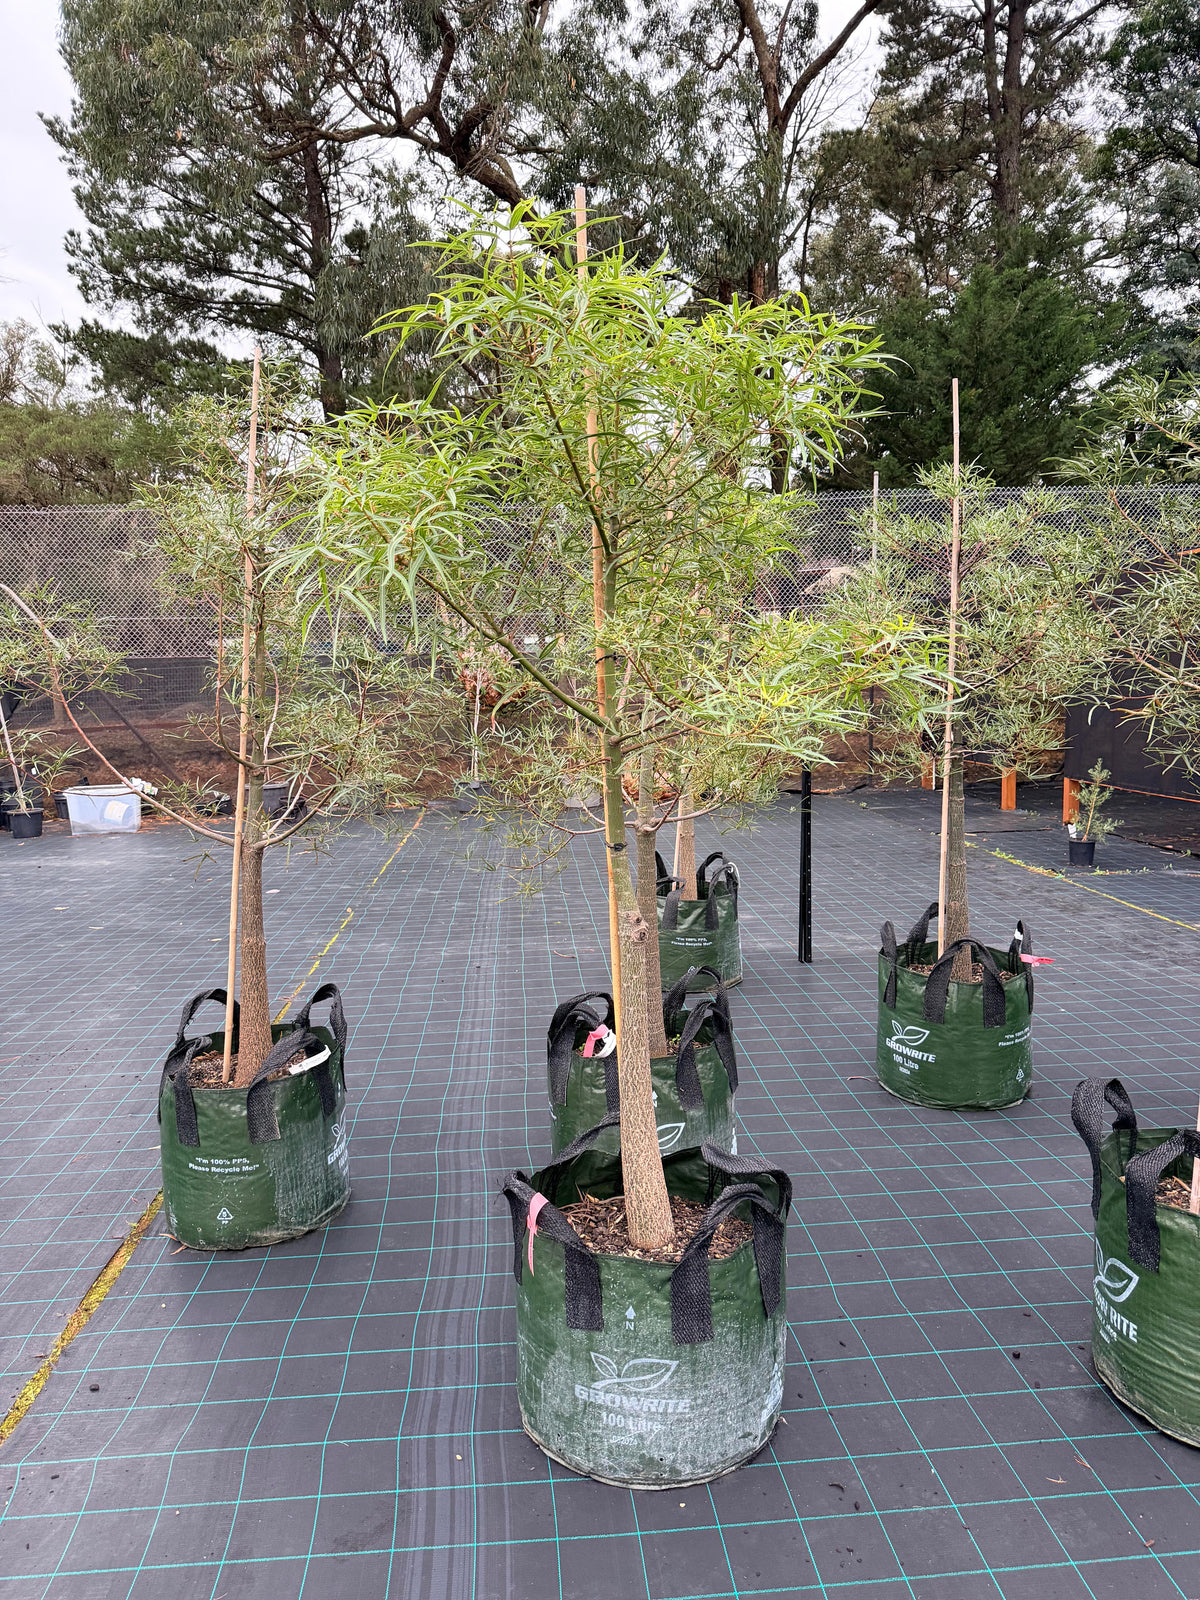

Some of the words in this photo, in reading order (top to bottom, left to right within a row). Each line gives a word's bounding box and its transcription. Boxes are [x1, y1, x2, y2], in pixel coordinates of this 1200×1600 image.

[885, 1037, 937, 1063] GROWRITE
[893, 1053, 903, 1064] 100
[903, 1057, 919, 1070] Litre
[188, 1162, 210, 1172] Please
[210, 1166, 240, 1174] Recycle
[625, 1320, 635, 1331] N
[574, 1384, 692, 1413] GROWRITE
[601, 1411, 625, 1428] 100
[628, 1416, 664, 1432] Litre
